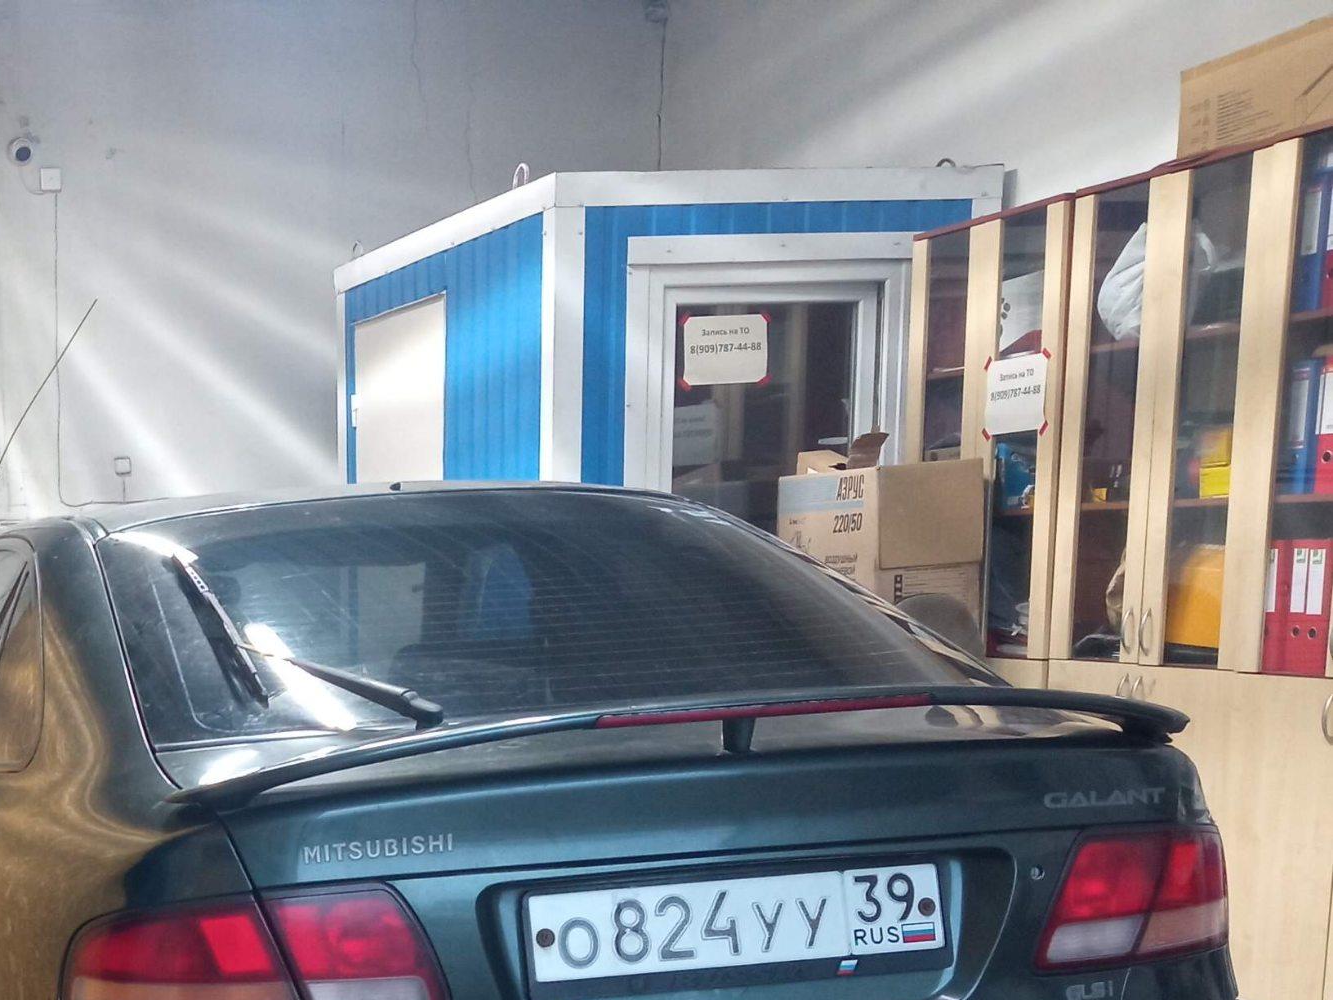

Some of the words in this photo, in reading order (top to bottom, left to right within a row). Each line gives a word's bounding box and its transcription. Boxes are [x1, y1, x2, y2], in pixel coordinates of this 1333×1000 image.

[690, 342, 762, 355] 8(909)787-44-88
[832, 512, 862, 534] 220/50
[1044, 787, 1165, 809] GALANT
[303, 833, 454, 865] MITSUBISHI
[853, 873, 915, 923] 39
[853, 925, 900, 947] RUS
